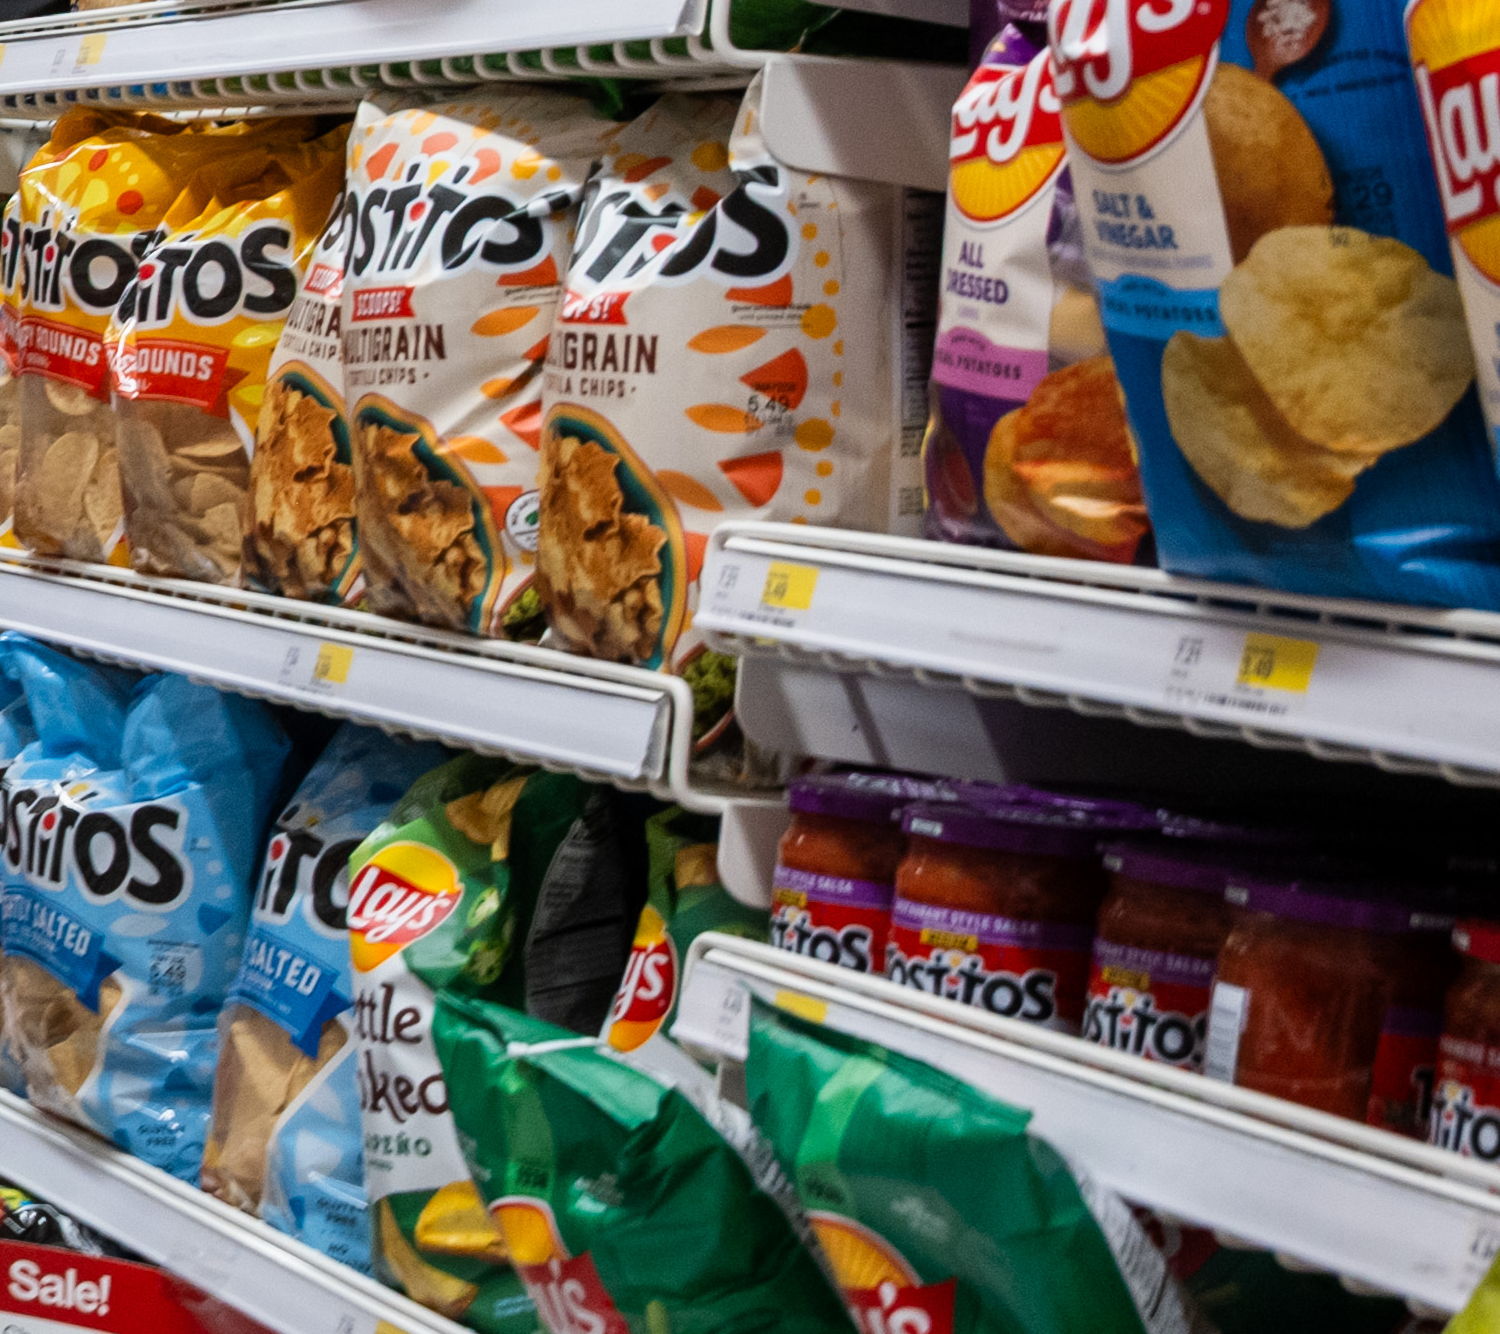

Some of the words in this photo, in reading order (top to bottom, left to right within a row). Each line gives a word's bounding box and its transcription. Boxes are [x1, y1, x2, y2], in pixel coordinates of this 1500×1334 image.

[958, 241, 985, 269] ALL
[349, 865, 463, 945] Lay's
[7, 1259, 111, 1317] Sale!
